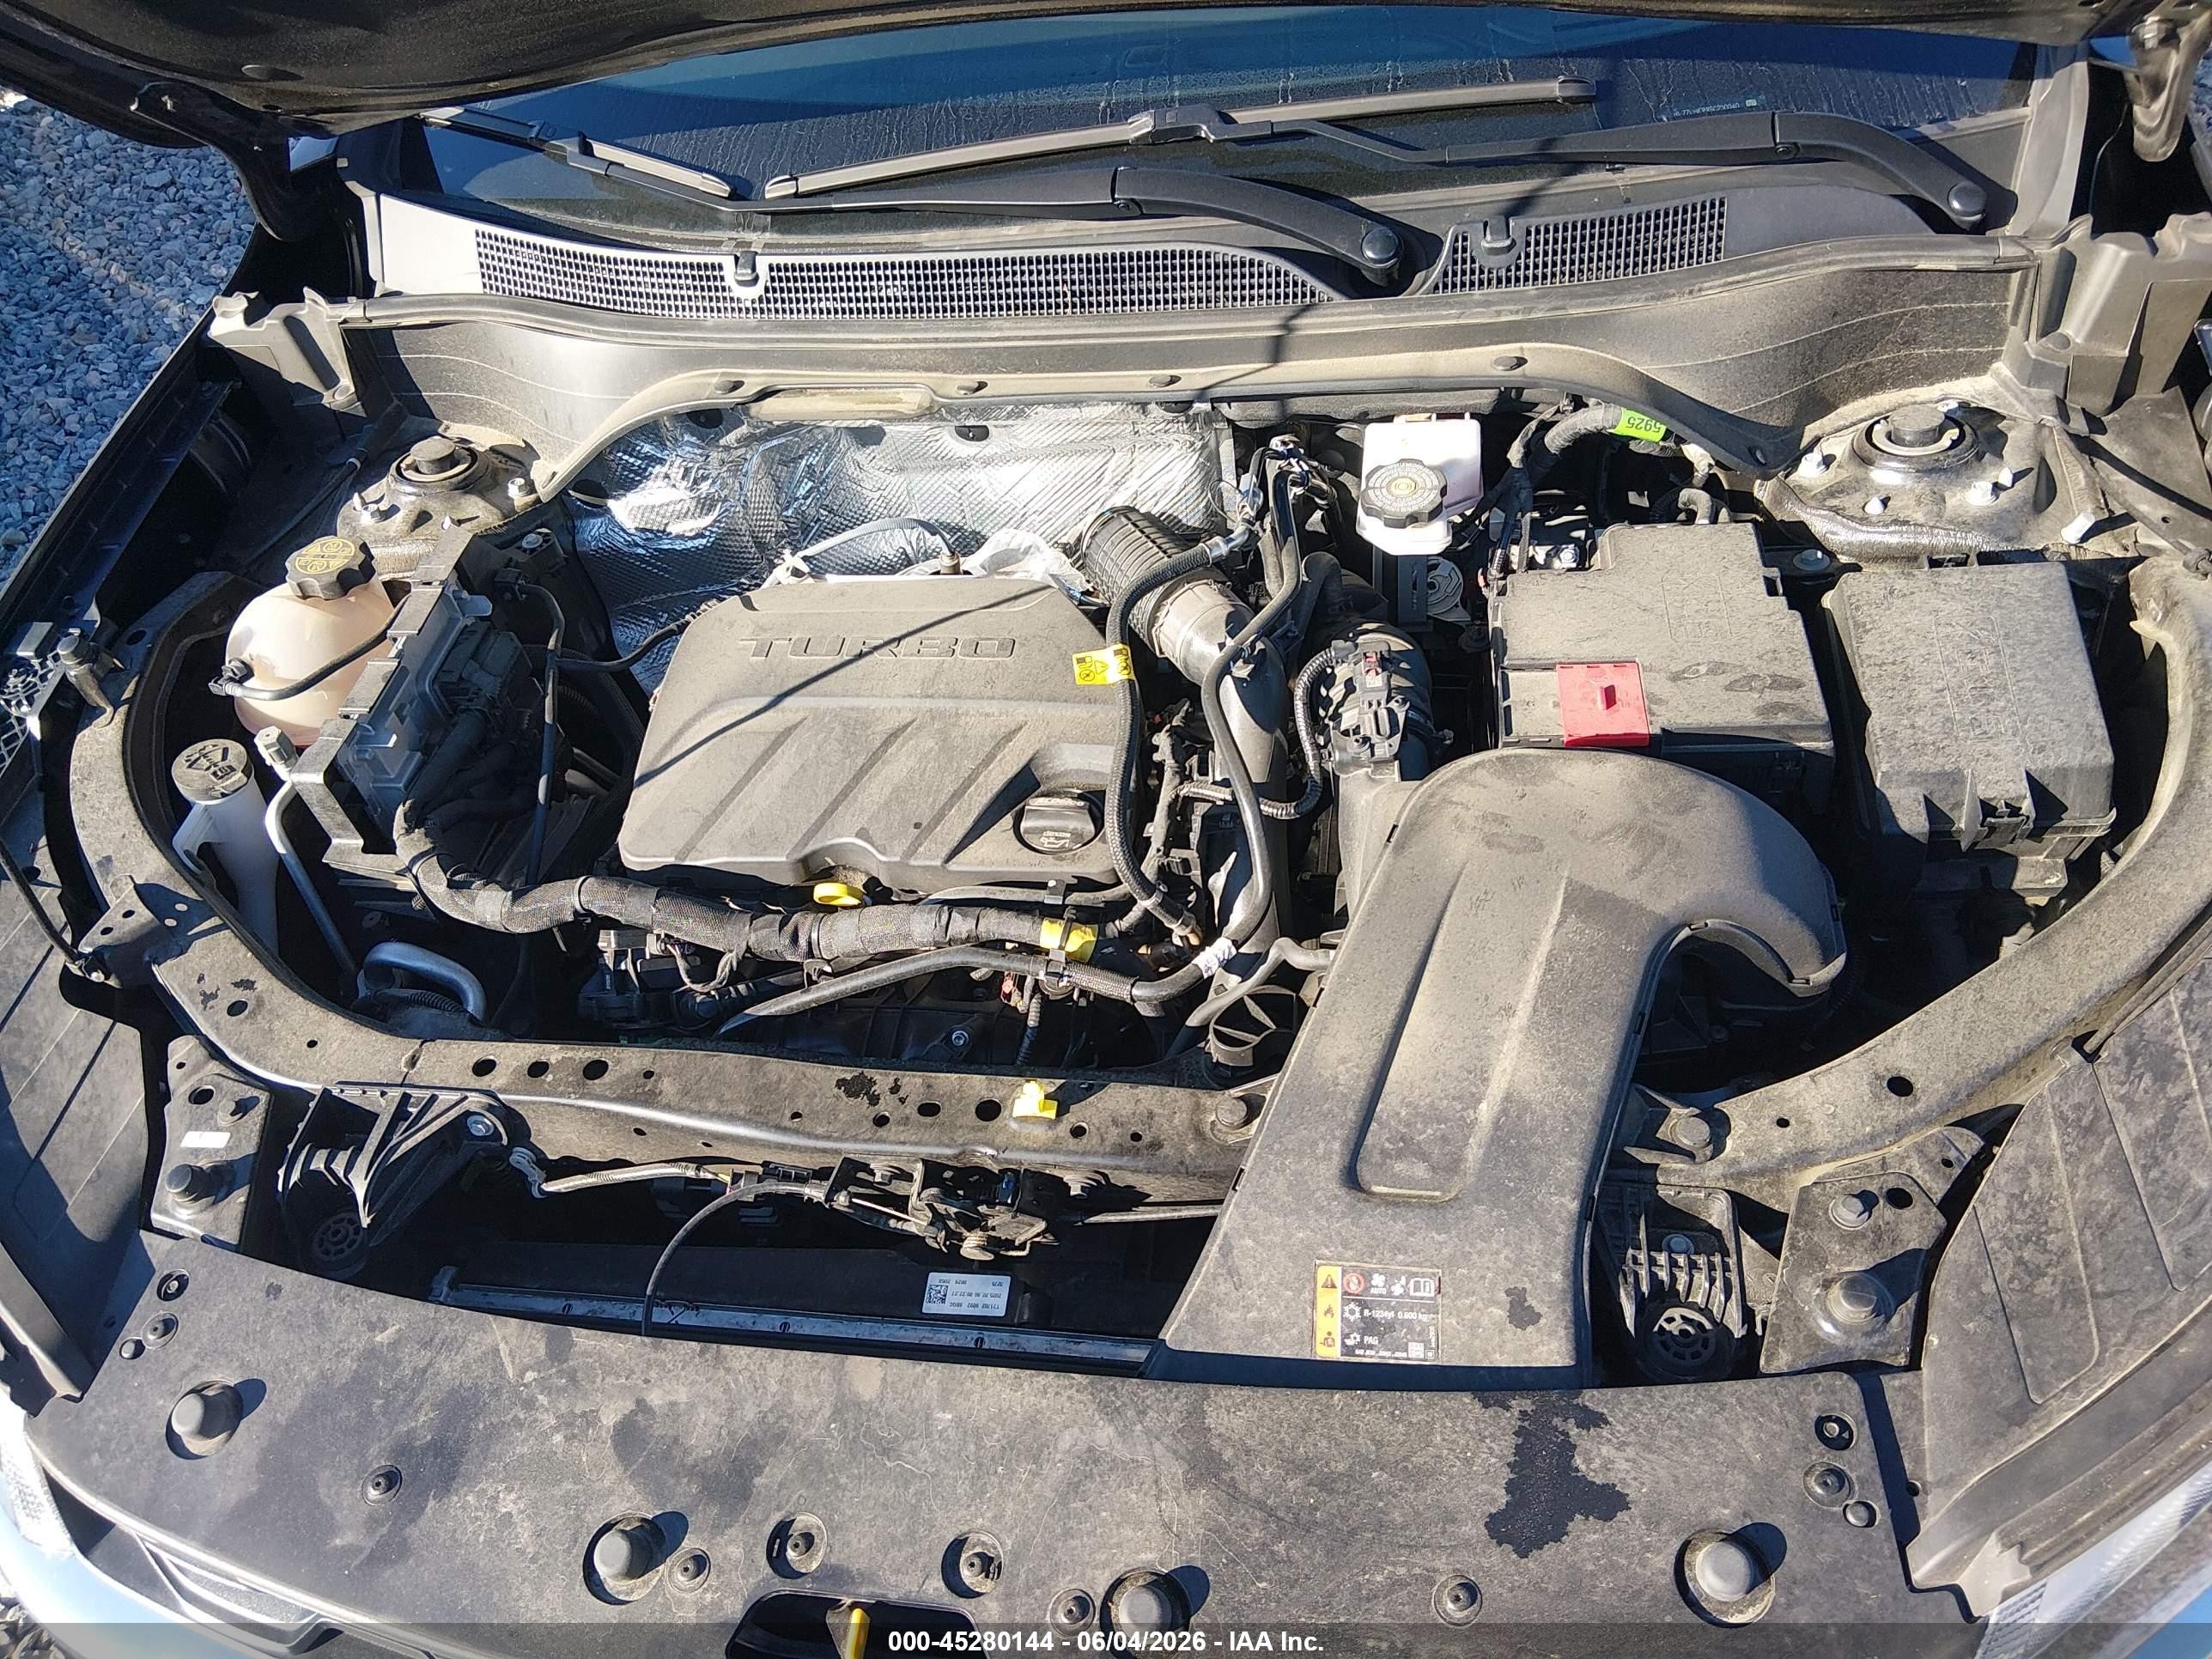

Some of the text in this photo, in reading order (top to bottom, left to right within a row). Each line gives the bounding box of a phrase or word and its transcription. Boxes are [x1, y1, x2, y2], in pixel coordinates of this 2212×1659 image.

[1626, 416, 1661, 433] 5925
[738, 636, 1016, 659] TURBO
[1364, 1309, 1395, 1320] R-1234yf
[1418, 1312, 1430, 1322] kg
[1364, 1335, 1379, 1345] PAG
